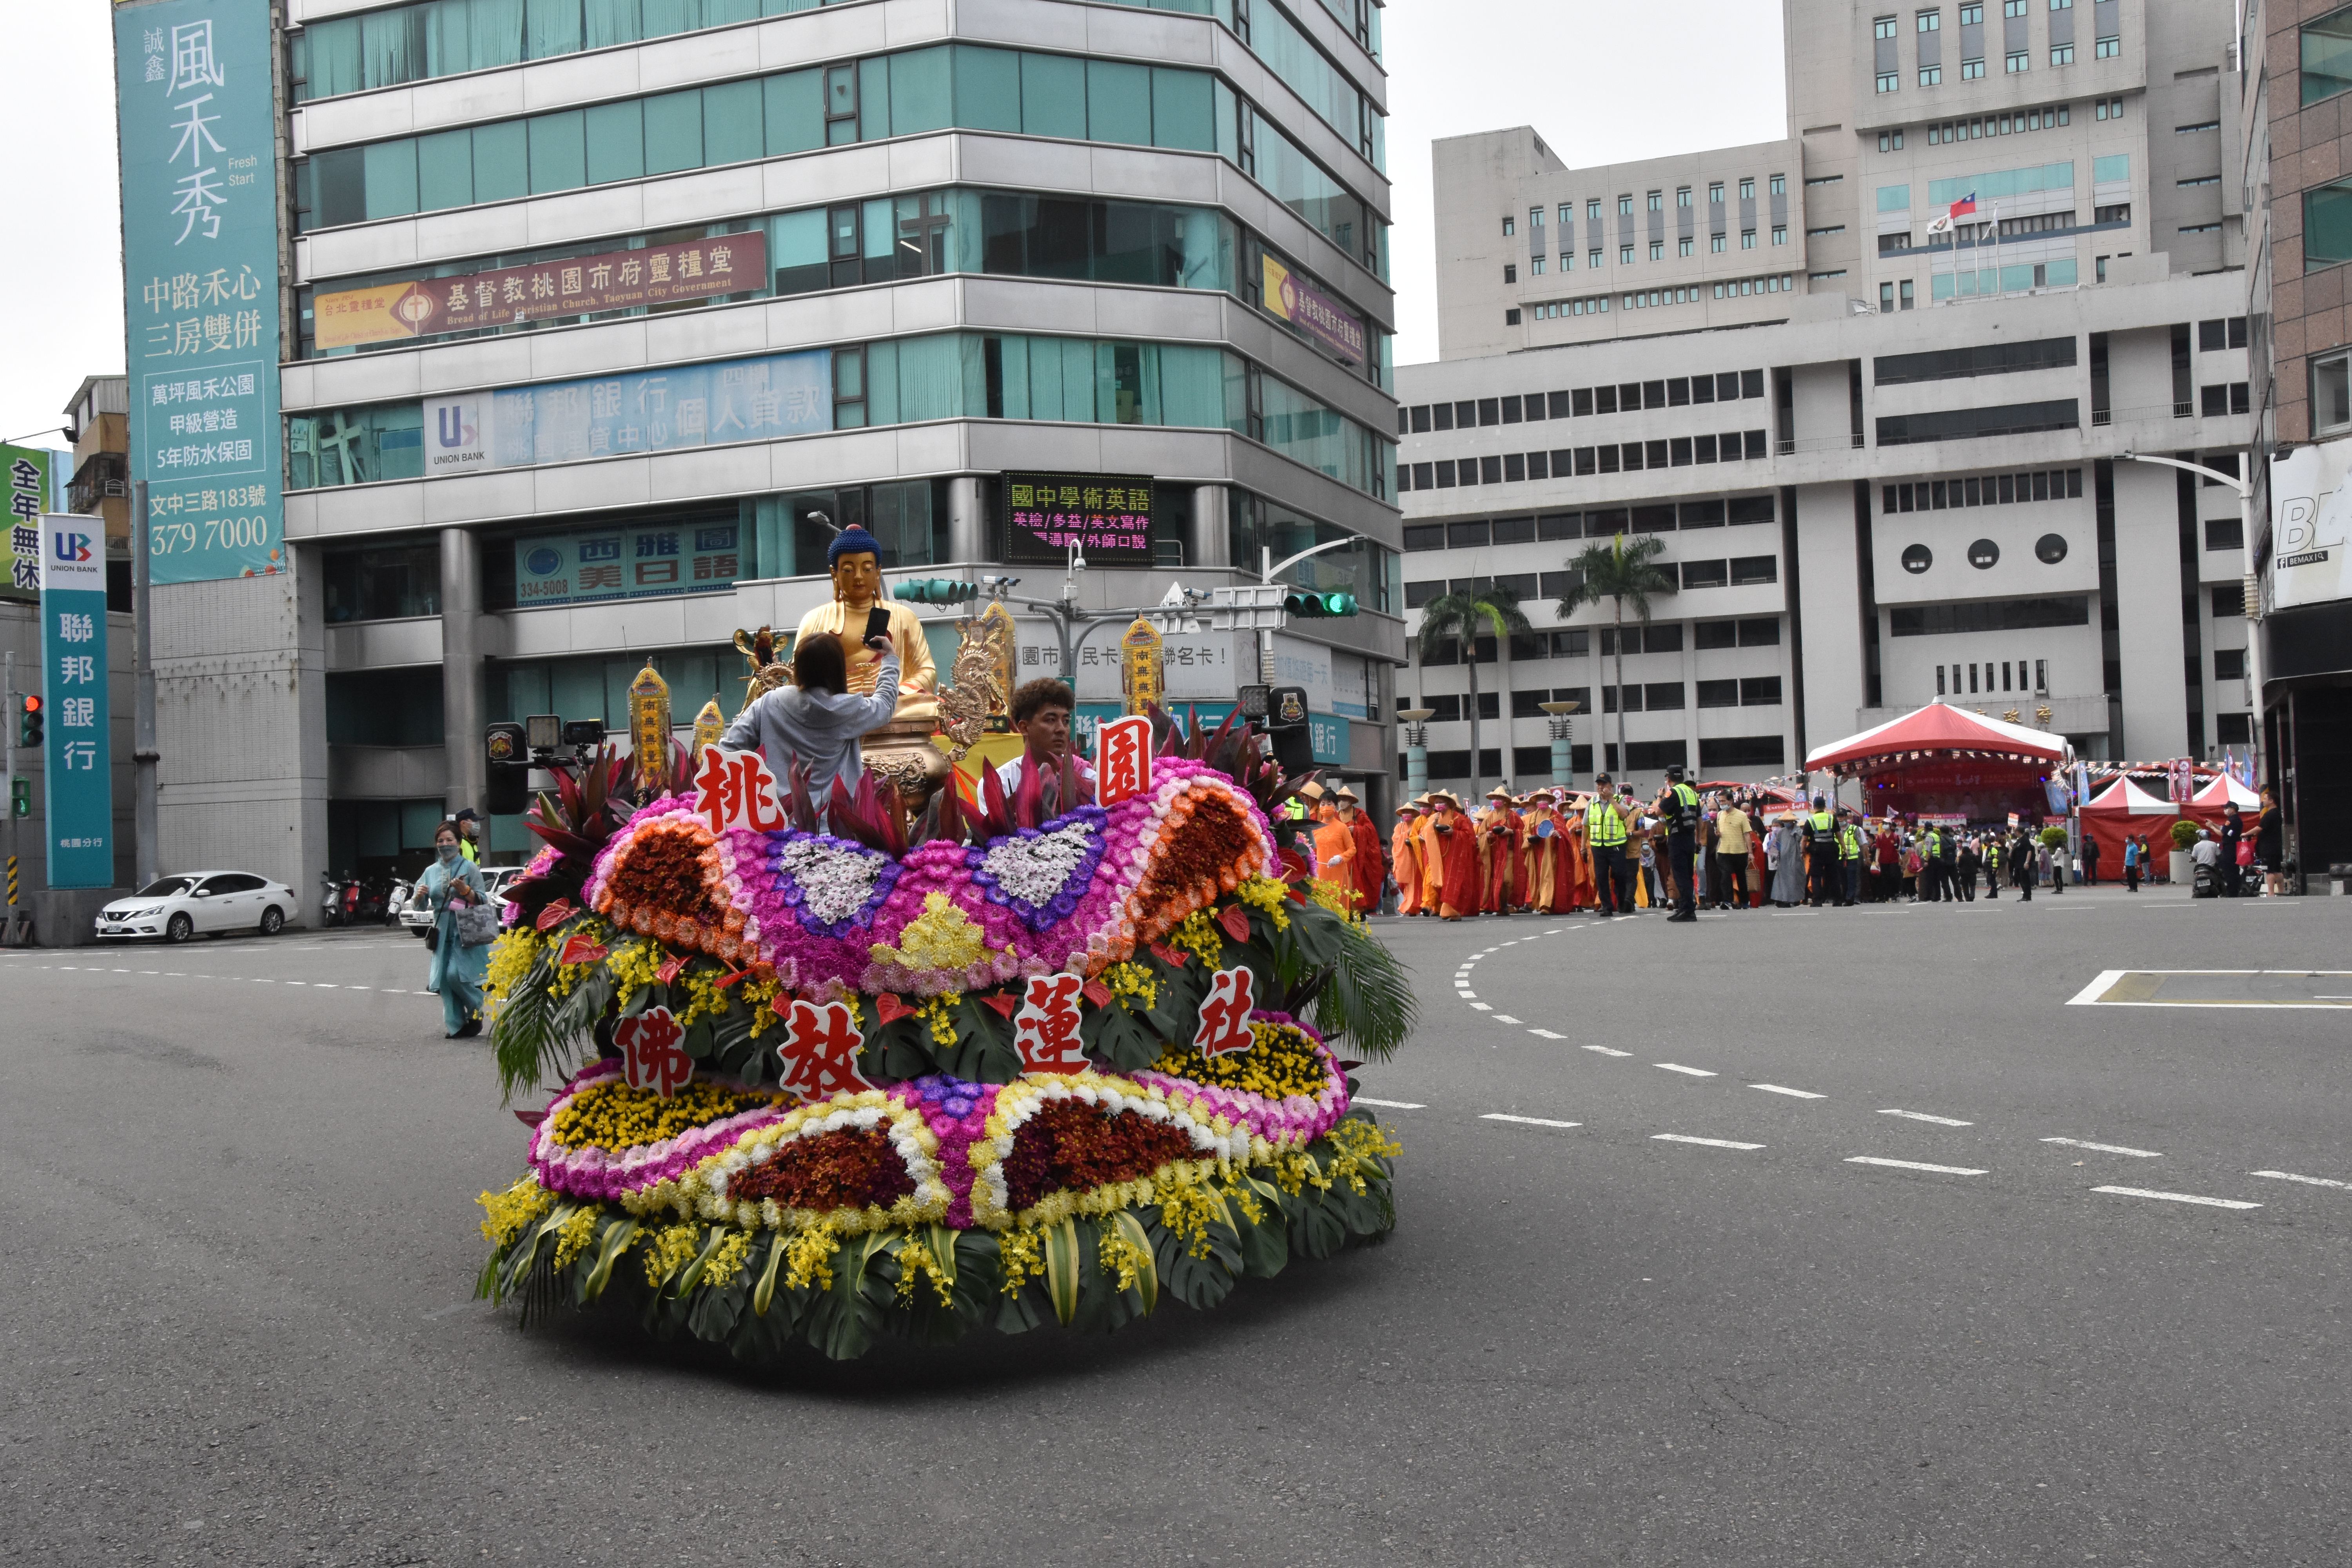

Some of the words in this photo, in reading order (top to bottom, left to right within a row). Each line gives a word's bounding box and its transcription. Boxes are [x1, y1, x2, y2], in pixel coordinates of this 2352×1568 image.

[144, 27, 165, 82] 誠鑫
[166, 20, 227, 245] 風禾秀
[229, 154, 257, 169] Fresh
[229, 173, 254, 186] Start
[144, 265, 261, 313] 中路禾心
[447, 245, 732, 311] 基督教桃園市府靈糧堂
[325, 297, 385, 316] 台北靈糧堂
[448, 314, 474, 325] Bread
[479, 312, 488, 321] of
[492, 309, 510, 319] Life
[515, 303, 557, 315] Christian
[563, 296, 599, 309] Church,
[604, 291, 642, 303] Taoyuan
[648, 287, 667, 298] City
[672, 278, 732, 294] Government
[145, 309, 262, 357] 三房雙併
[152, 374, 254, 406] 萬坪風禾公園
[505, 377, 667, 427] 聯邦銀行
[171, 408, 238, 435] 甲級營造
[157, 439, 252, 468] 5年防水保固
[434, 454, 459, 465] UNION
[462, 451, 485, 462] BANK
[150, 484, 266, 517] 文中三路183號
[1012, 485, 1149, 511] 國中學術英語
[11, 458, 41, 589] 全年無休
[151, 523, 196, 555] 379
[205, 515, 267, 550] 7000
[579, 526, 737, 563] 西雅圖
[2290, 555, 2313, 565] BEMAX
[521, 579, 568, 597] 334-5008
[579, 554, 738, 590] 美日語
[60, 613, 96, 770] 聯邦銀行
[1309, 722, 1336, 755] 銀行
[1100, 720, 1150, 807] 園
[697, 749, 785, 834] 桃
[60, 838, 103, 848] 桃園分行
[615, 1009, 692, 1098] 佛
[780, 1005, 870, 1100] 教
[1019, 977, 1089, 1075] 蓮
[1196, 968, 1253, 1056] 社
